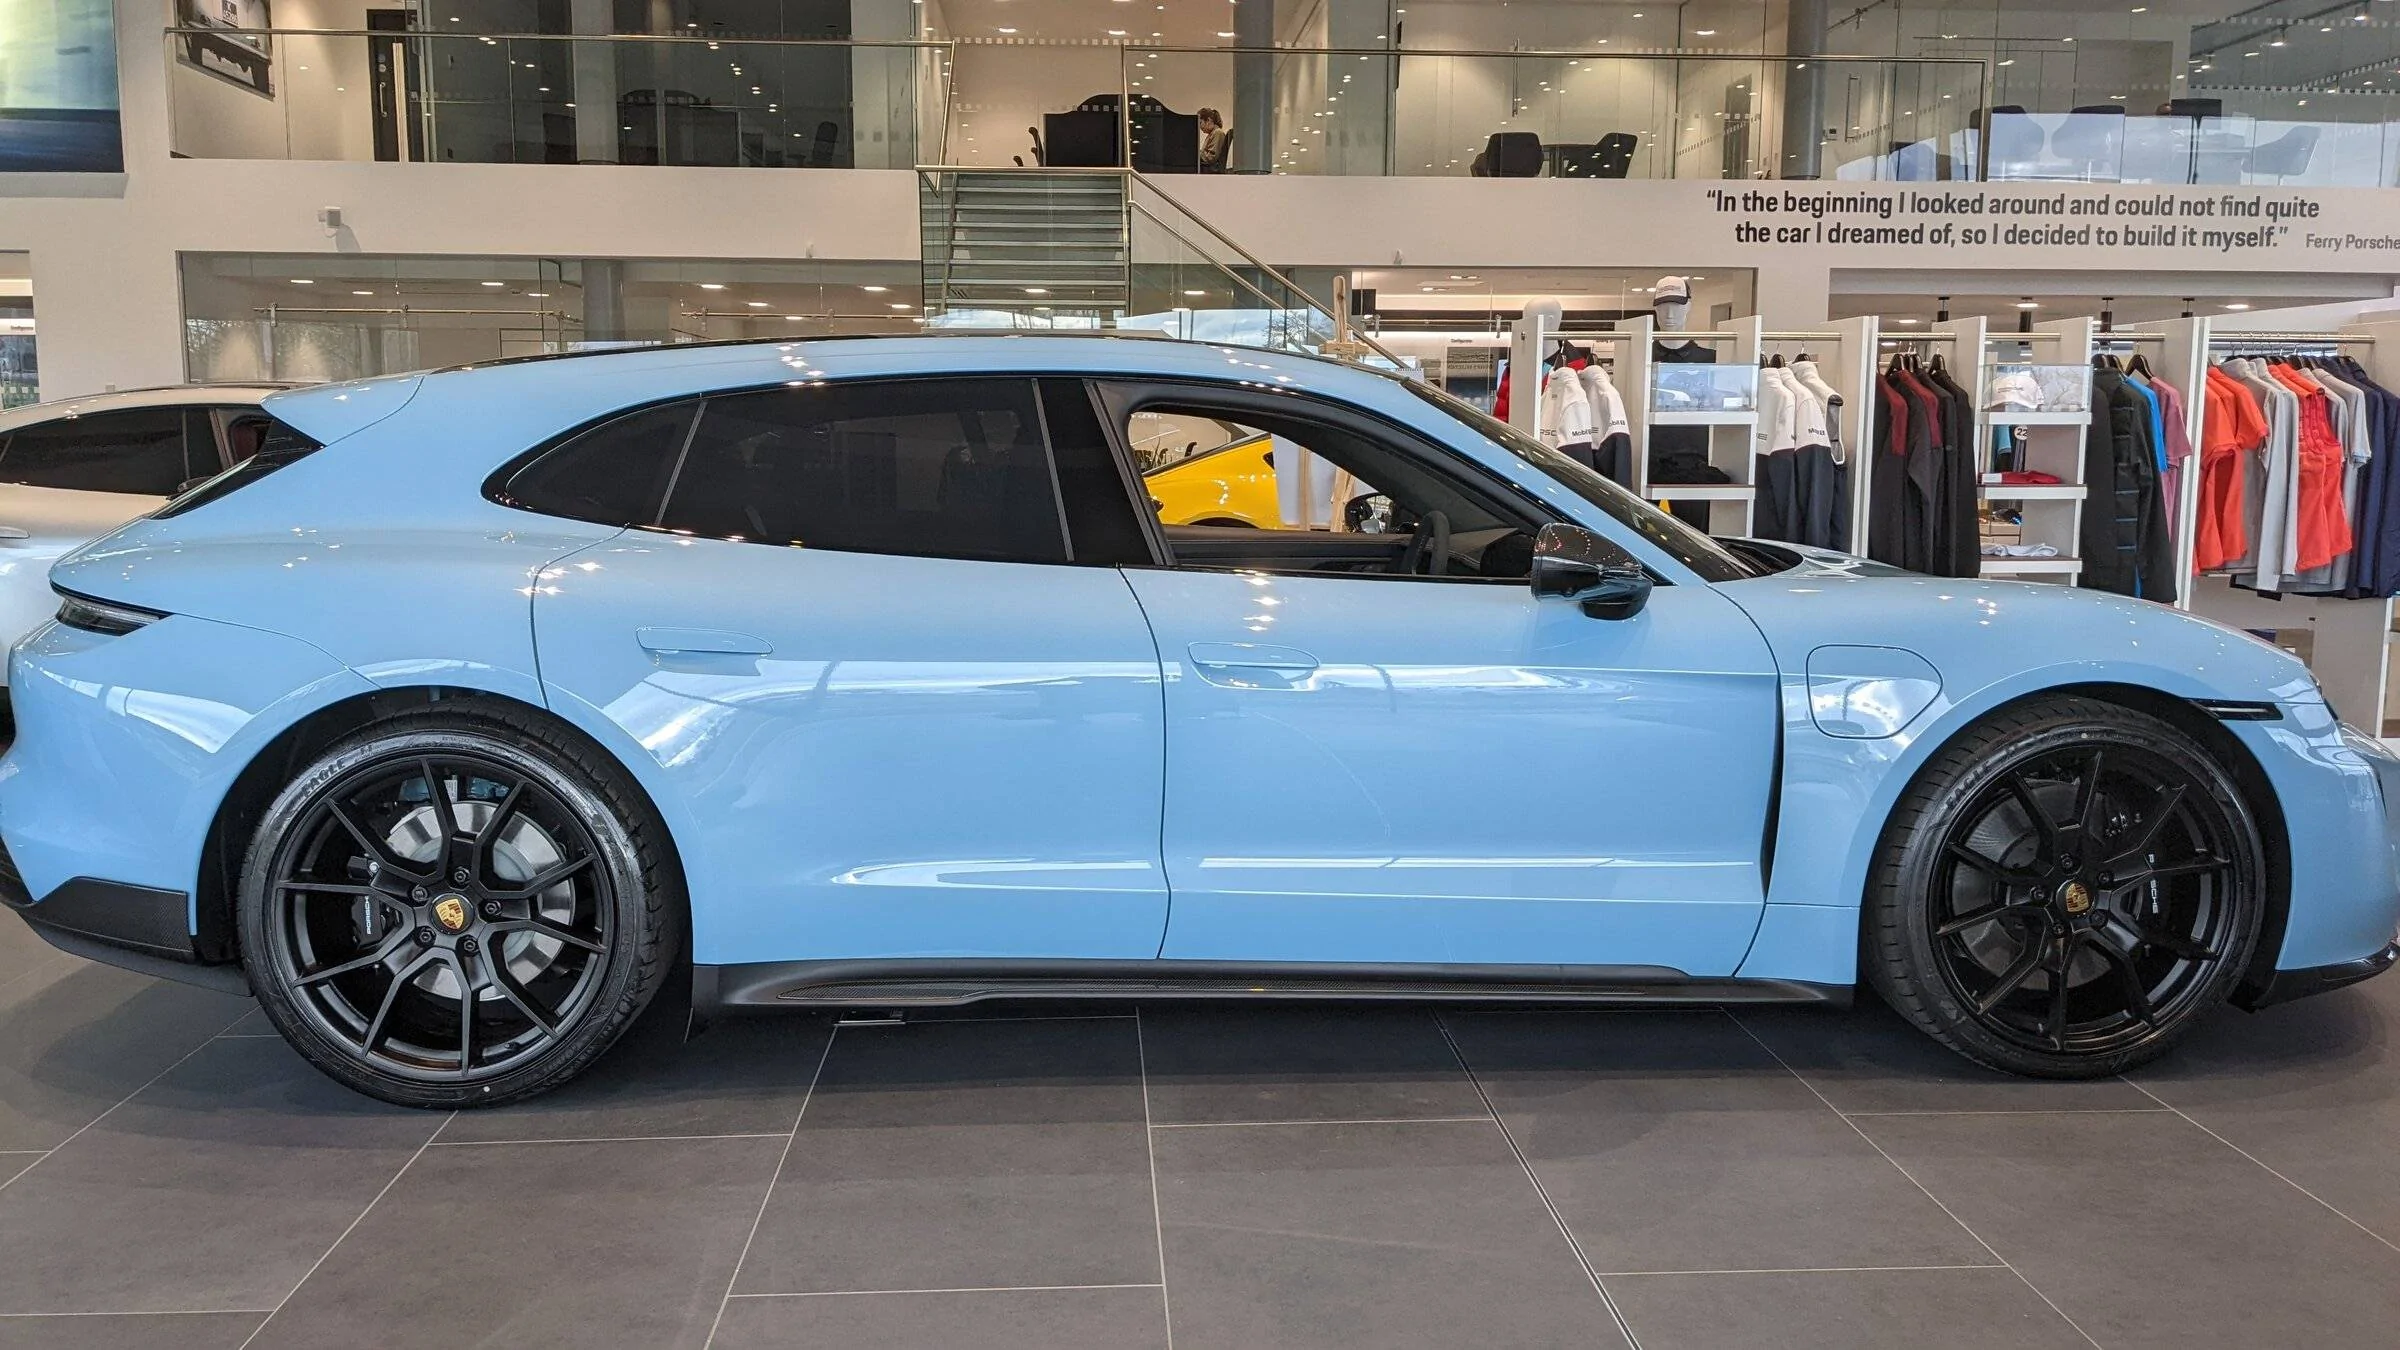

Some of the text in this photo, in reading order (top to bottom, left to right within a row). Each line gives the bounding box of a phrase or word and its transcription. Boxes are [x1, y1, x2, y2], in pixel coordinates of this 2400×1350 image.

[1742, 190, 1778, 213] the
[1784, 190, 1893, 219] beginning
[1898, 191, 1905, 213] I
[1911, 192, 1984, 214] looked
[1988, 193, 2065, 215] around
[2070, 194, 2110, 216] and
[2114, 194, 2175, 217] could
[2179, 197, 2216, 217] not
[2220, 194, 2261, 217] find
[2265, 195, 2320, 223] quite
[1735, 221, 1771, 243] the
[1776, 226, 1811, 243] car
[1816, 221, 1822, 243] I
[1828, 222, 1924, 245] dreamed
[1929, 223, 1956, 248] of,
[1961, 228, 1987, 245] so
[1992, 223, 1998, 245] I
[2004, 223, 2091, 246] decided
[2095, 226, 2118, 247] to
[2123, 224, 2177, 248] build
[2181, 224, 2198, 247] it
[2305, 233, 2400, 252] Ferry Porsche
[301, 758, 346, 797] EAGLE
[2148, 853, 2159, 915] PSCHE
[364, 895, 372, 935] PORSCH
